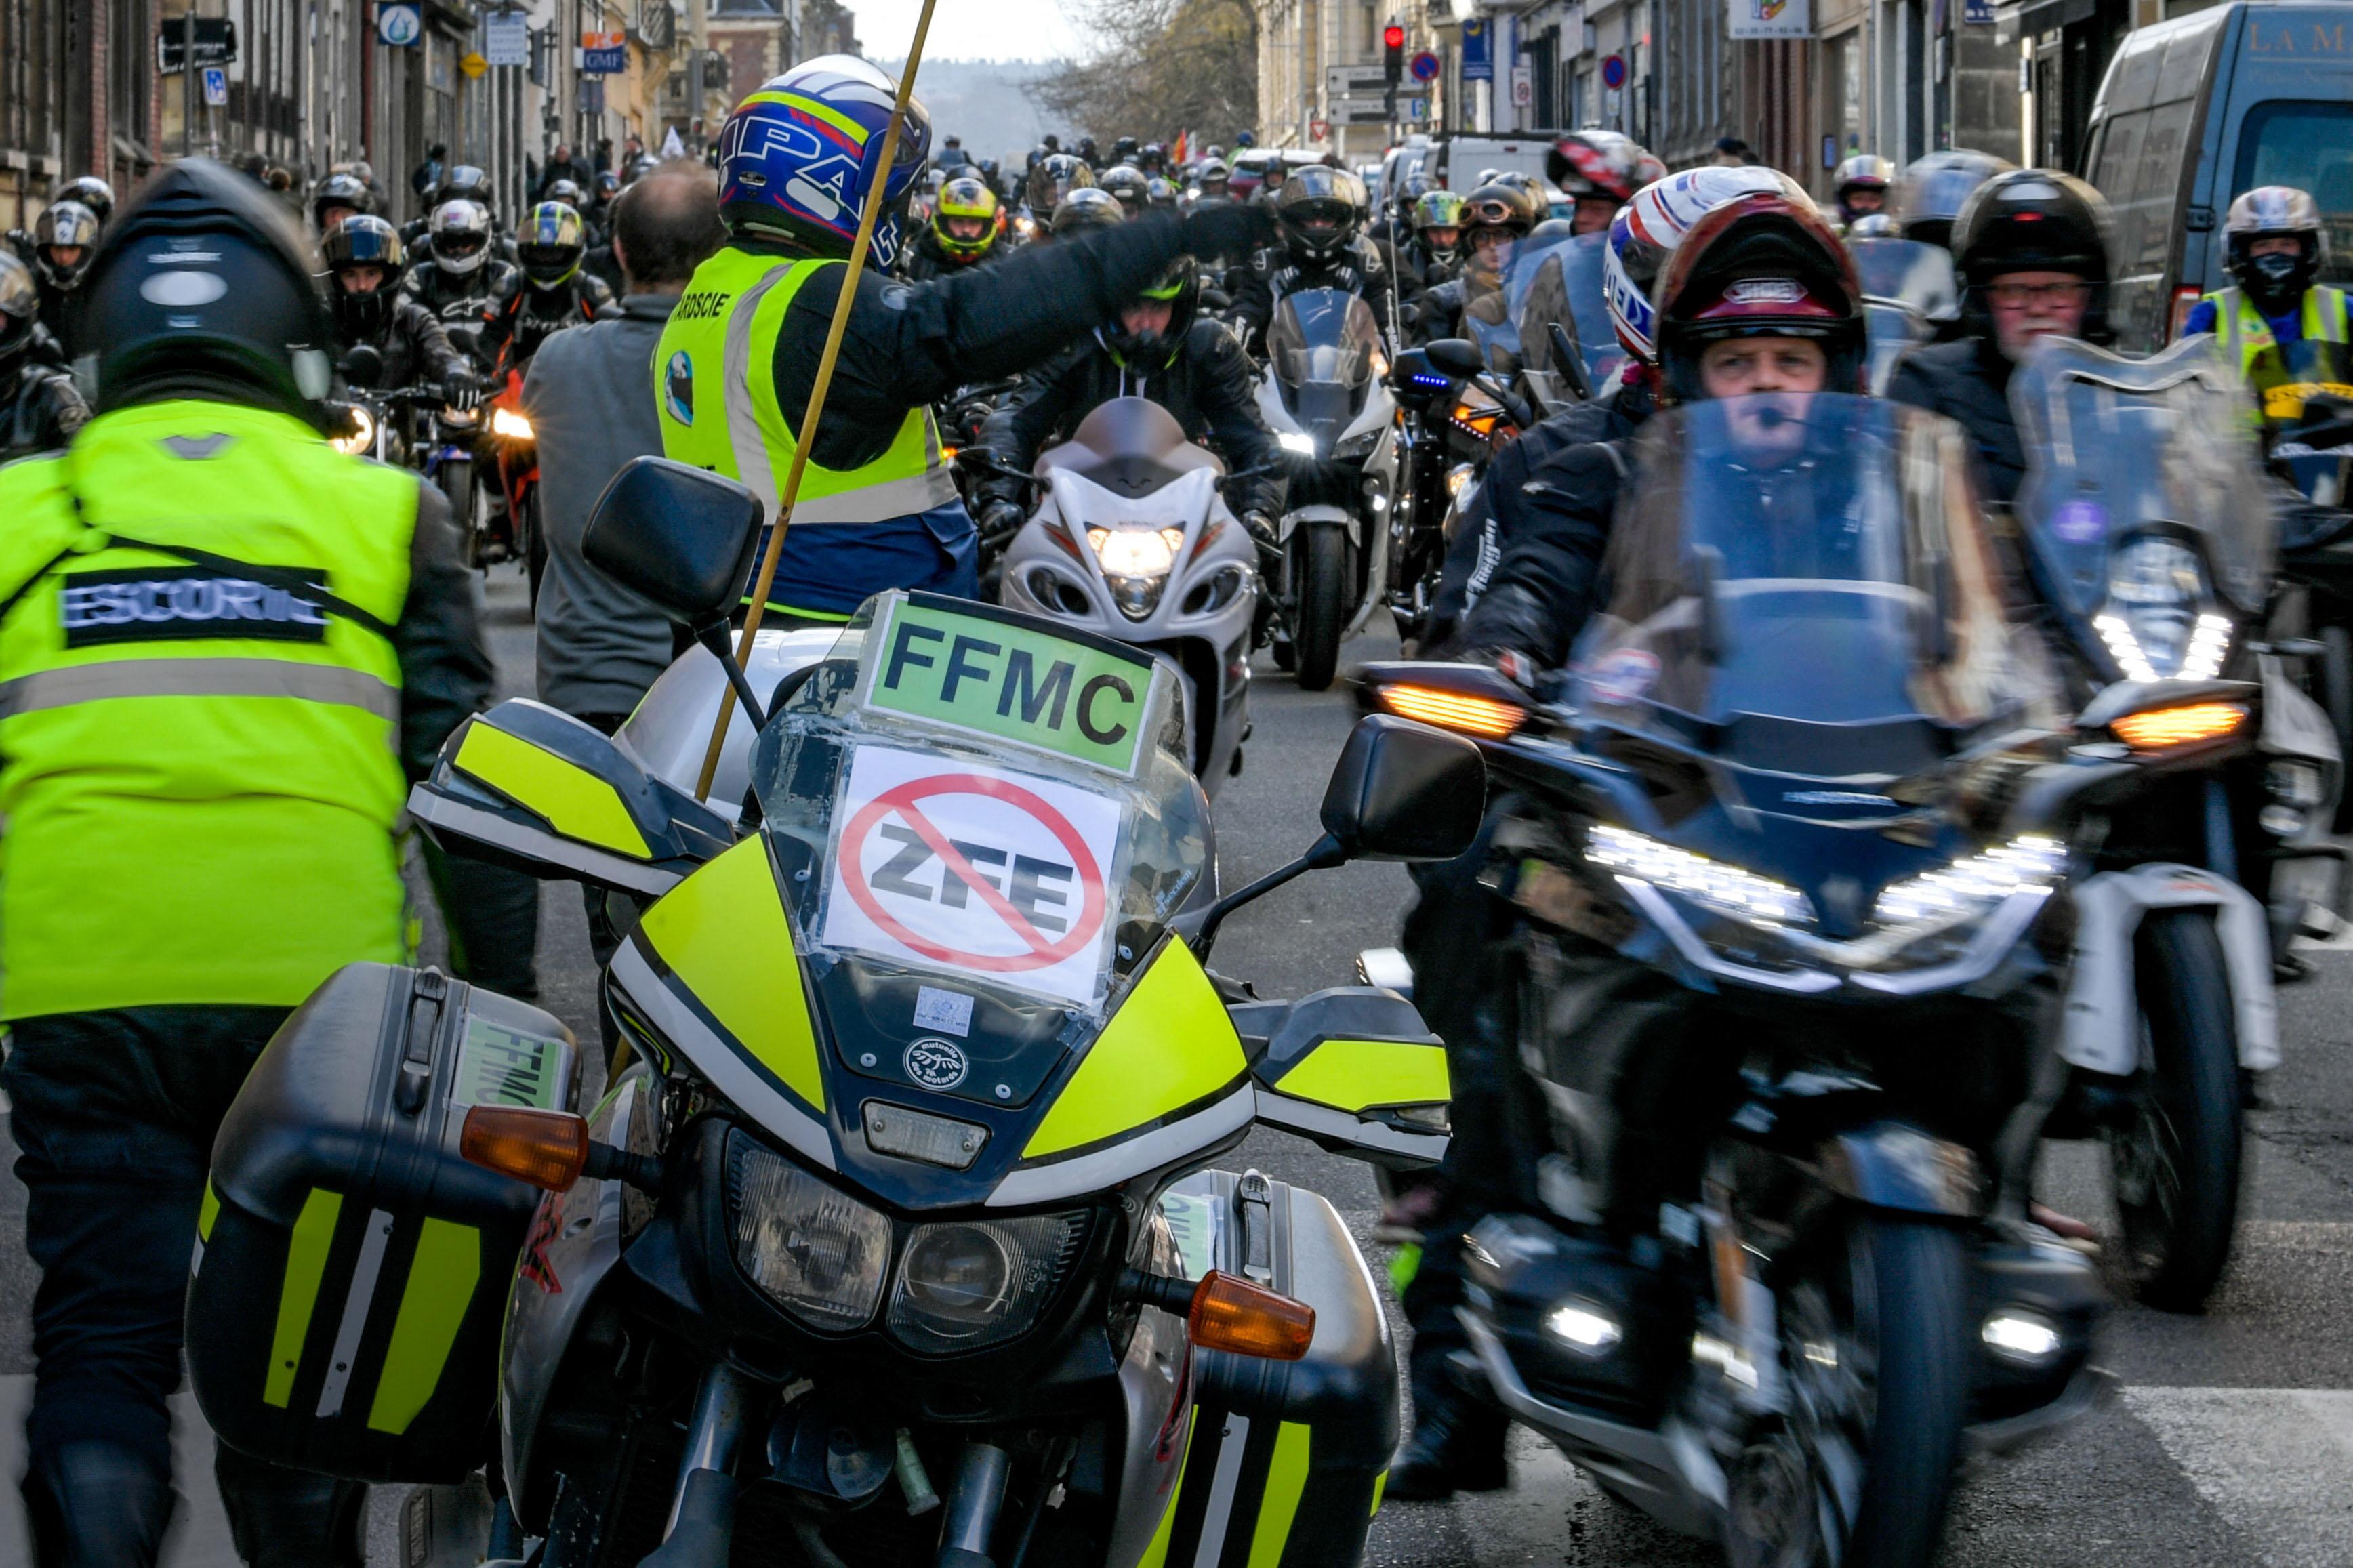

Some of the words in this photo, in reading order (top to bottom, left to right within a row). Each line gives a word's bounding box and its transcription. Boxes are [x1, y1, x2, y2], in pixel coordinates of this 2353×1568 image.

[2250, 22, 2294, 51] LA
[2311, 24, 2353, 52] M
[586, 53, 621, 68] GMF
[883, 622, 1135, 745] FFMC
[870, 823, 1073, 934] ZFE
[921, 1041, 958, 1059] mutuelle
[911, 1061, 922, 1076] des
[923, 1071, 958, 1084] motards
